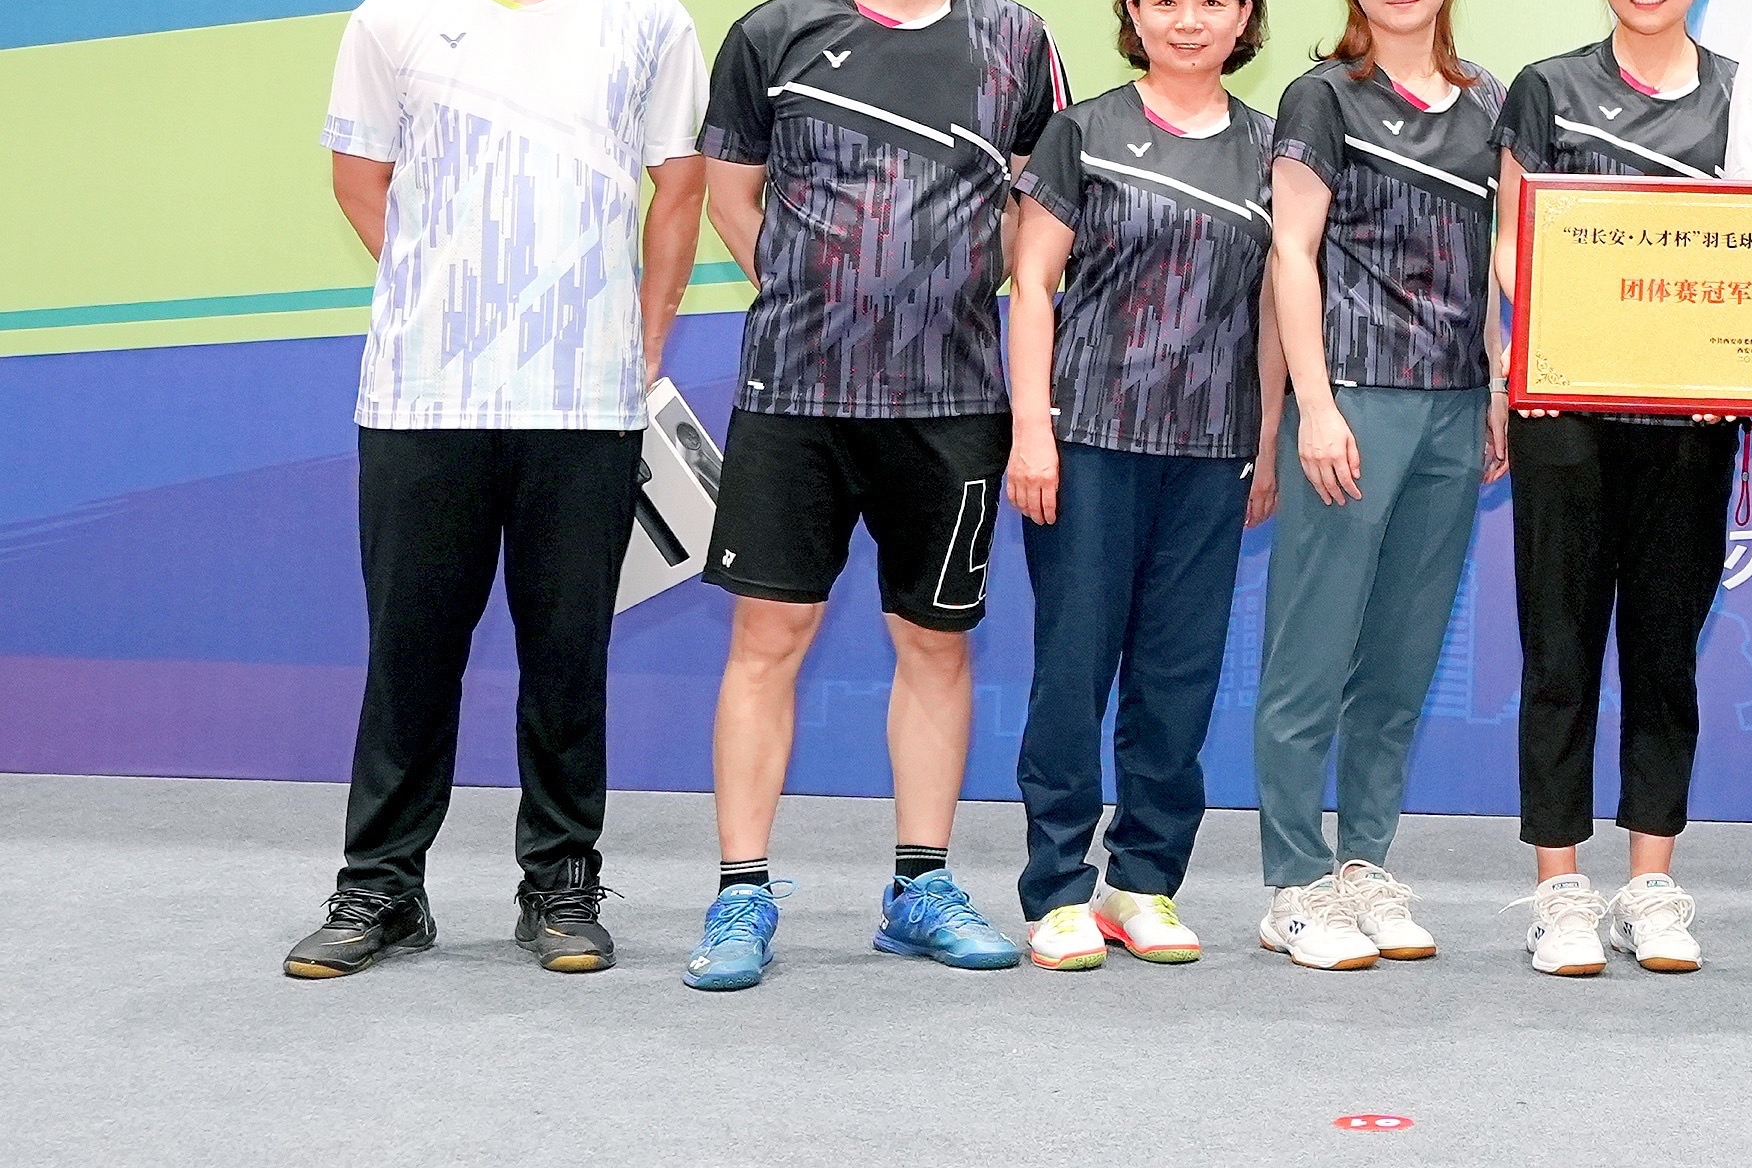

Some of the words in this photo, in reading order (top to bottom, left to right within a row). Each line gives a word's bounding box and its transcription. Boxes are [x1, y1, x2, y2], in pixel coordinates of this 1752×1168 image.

[1620, 278, 1752, 305] 团体赛冠军
